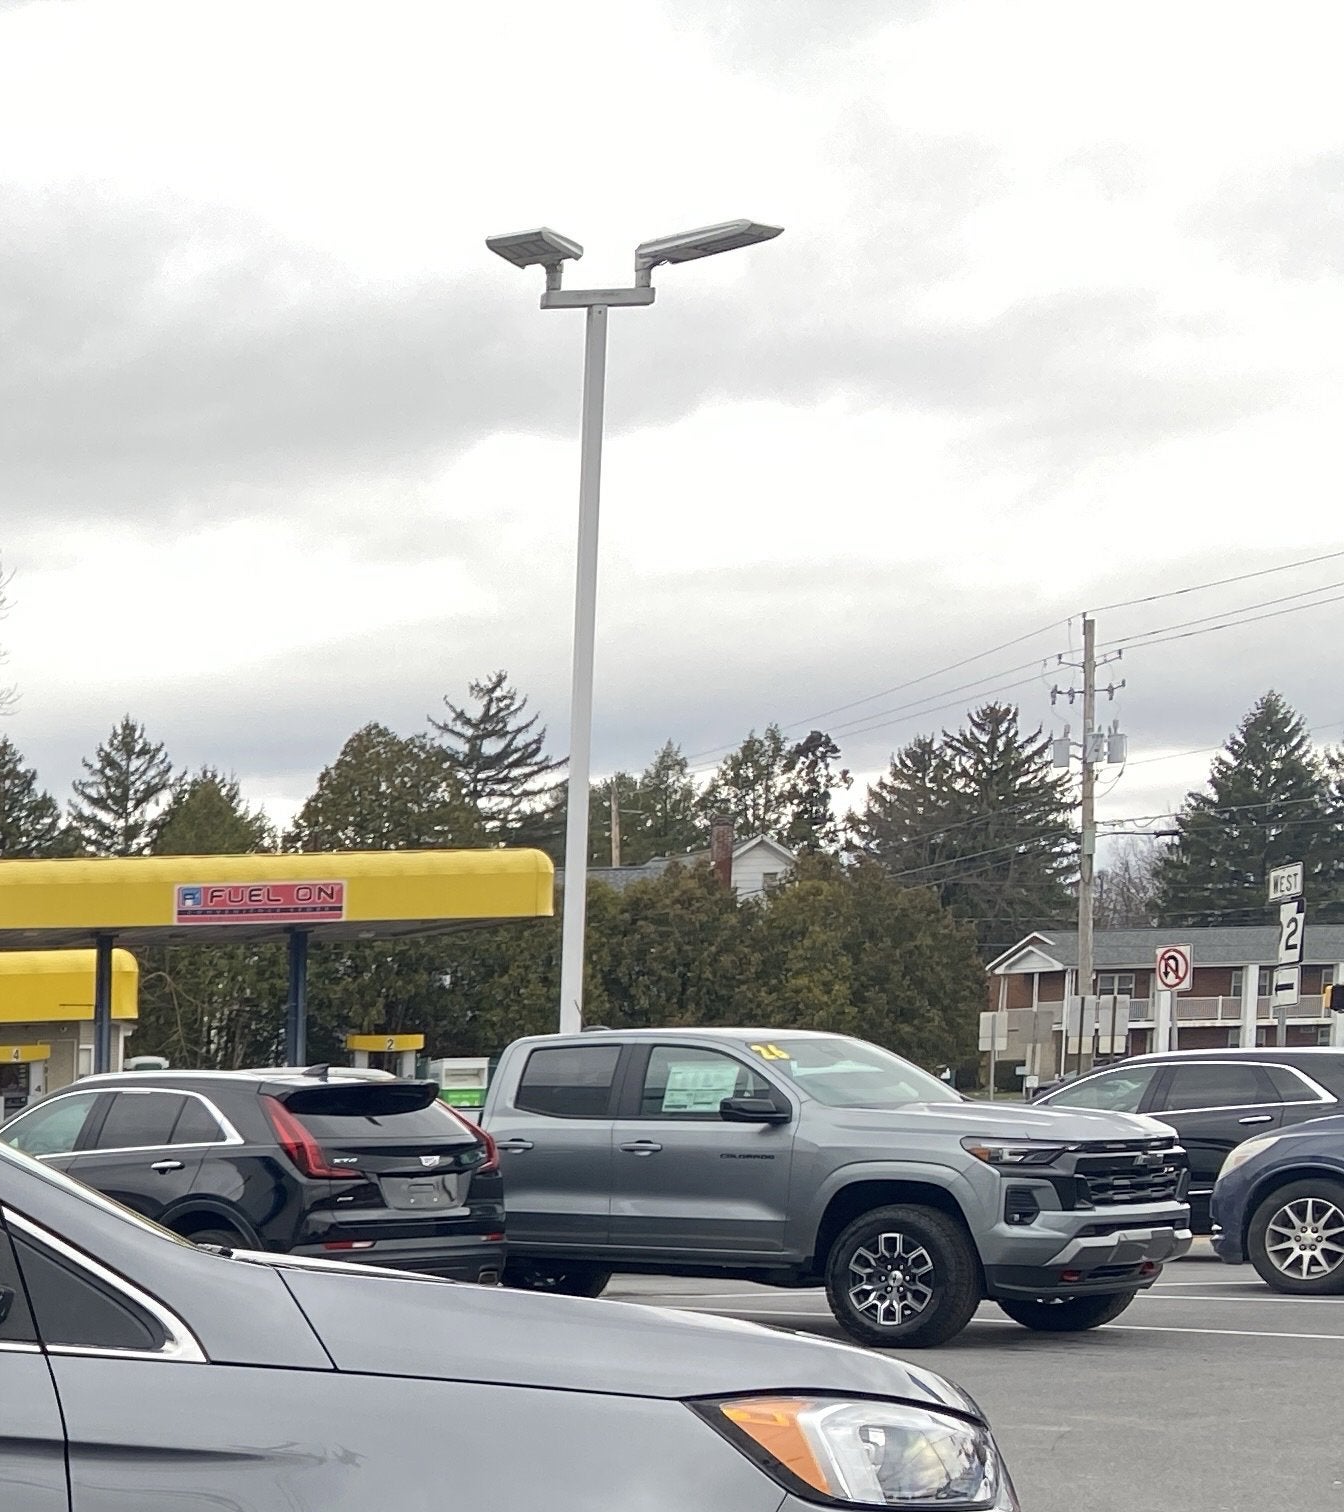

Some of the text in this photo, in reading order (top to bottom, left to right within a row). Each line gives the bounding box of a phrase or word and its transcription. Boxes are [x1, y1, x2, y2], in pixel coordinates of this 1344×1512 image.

[1272, 872, 1299, 895] WEST
[209, 886, 334, 904] FUEL ON
[1285, 916, 1298, 950] 2
[387, 1039, 394, 1050] 2
[13, 1049, 20, 1060] 4
